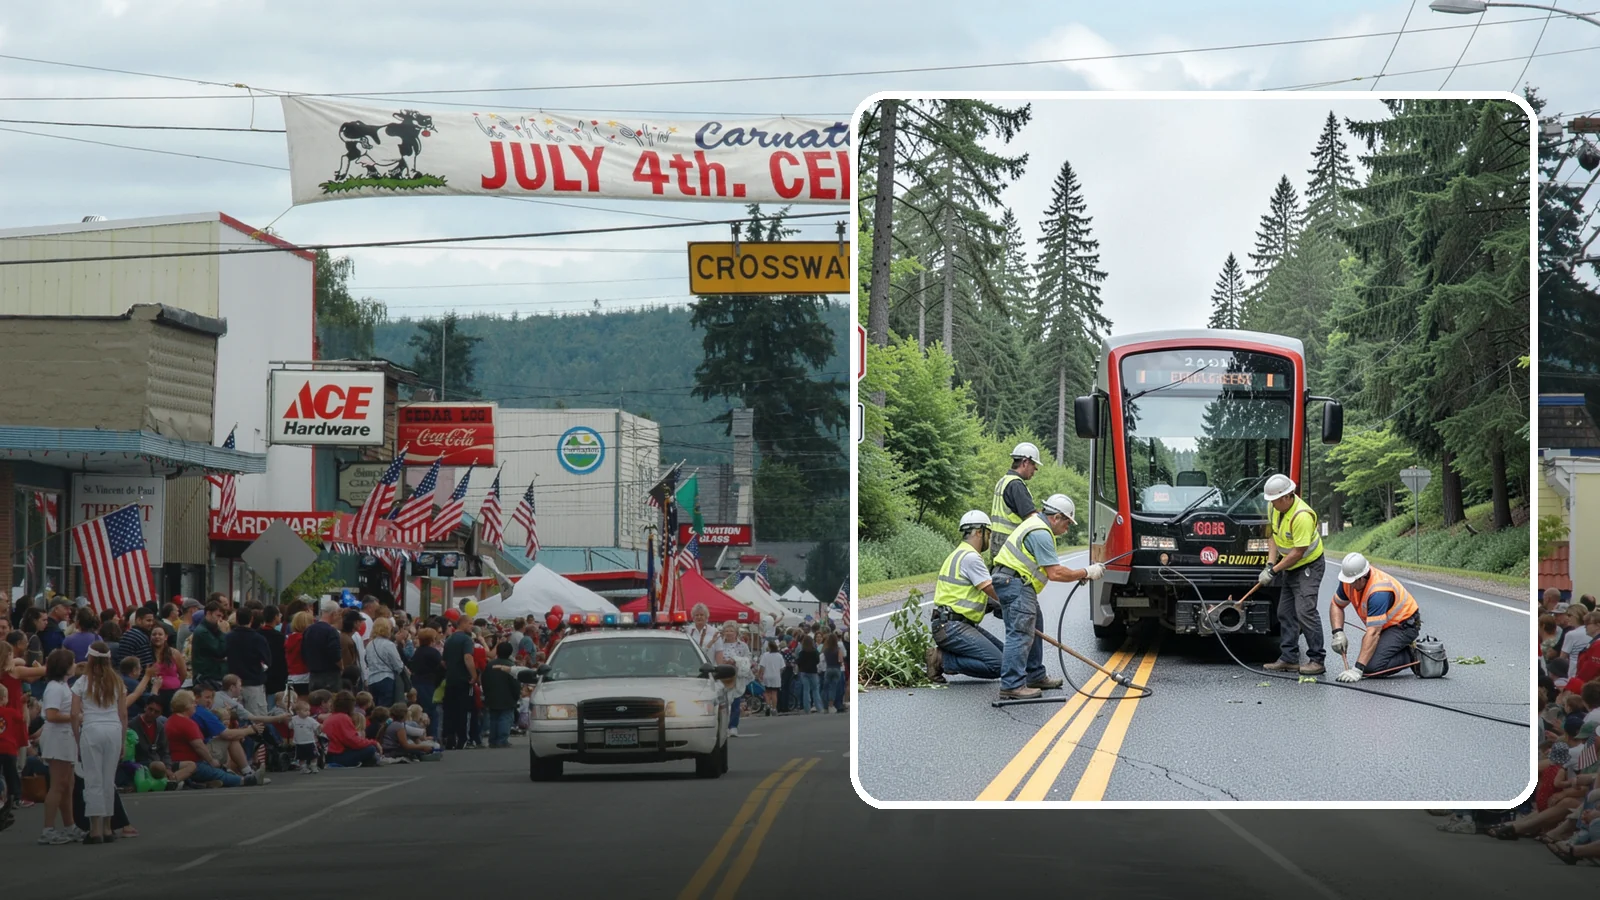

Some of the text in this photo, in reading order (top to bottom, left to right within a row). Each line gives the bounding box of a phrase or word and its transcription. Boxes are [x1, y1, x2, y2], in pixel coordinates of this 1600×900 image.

[695, 121, 850, 150] Carnat
[481, 141, 605, 192] JULY
[632, 150, 746, 197] 4th.
[697, 254, 850, 280] CROSSWA
[283, 380, 374, 420] ACE
[405, 408, 485, 422] CEDAR LOG
[283, 421, 371, 436] Hardware
[354, 467, 386, 480] Simpl
[83, 485, 155, 495] St. Vincent de Paul
[81, 504, 153, 521] THT
[212, 516, 330, 536] HARDARE
[687, 526, 741, 535] CRNATION
[699, 535, 730, 543] GLASS
